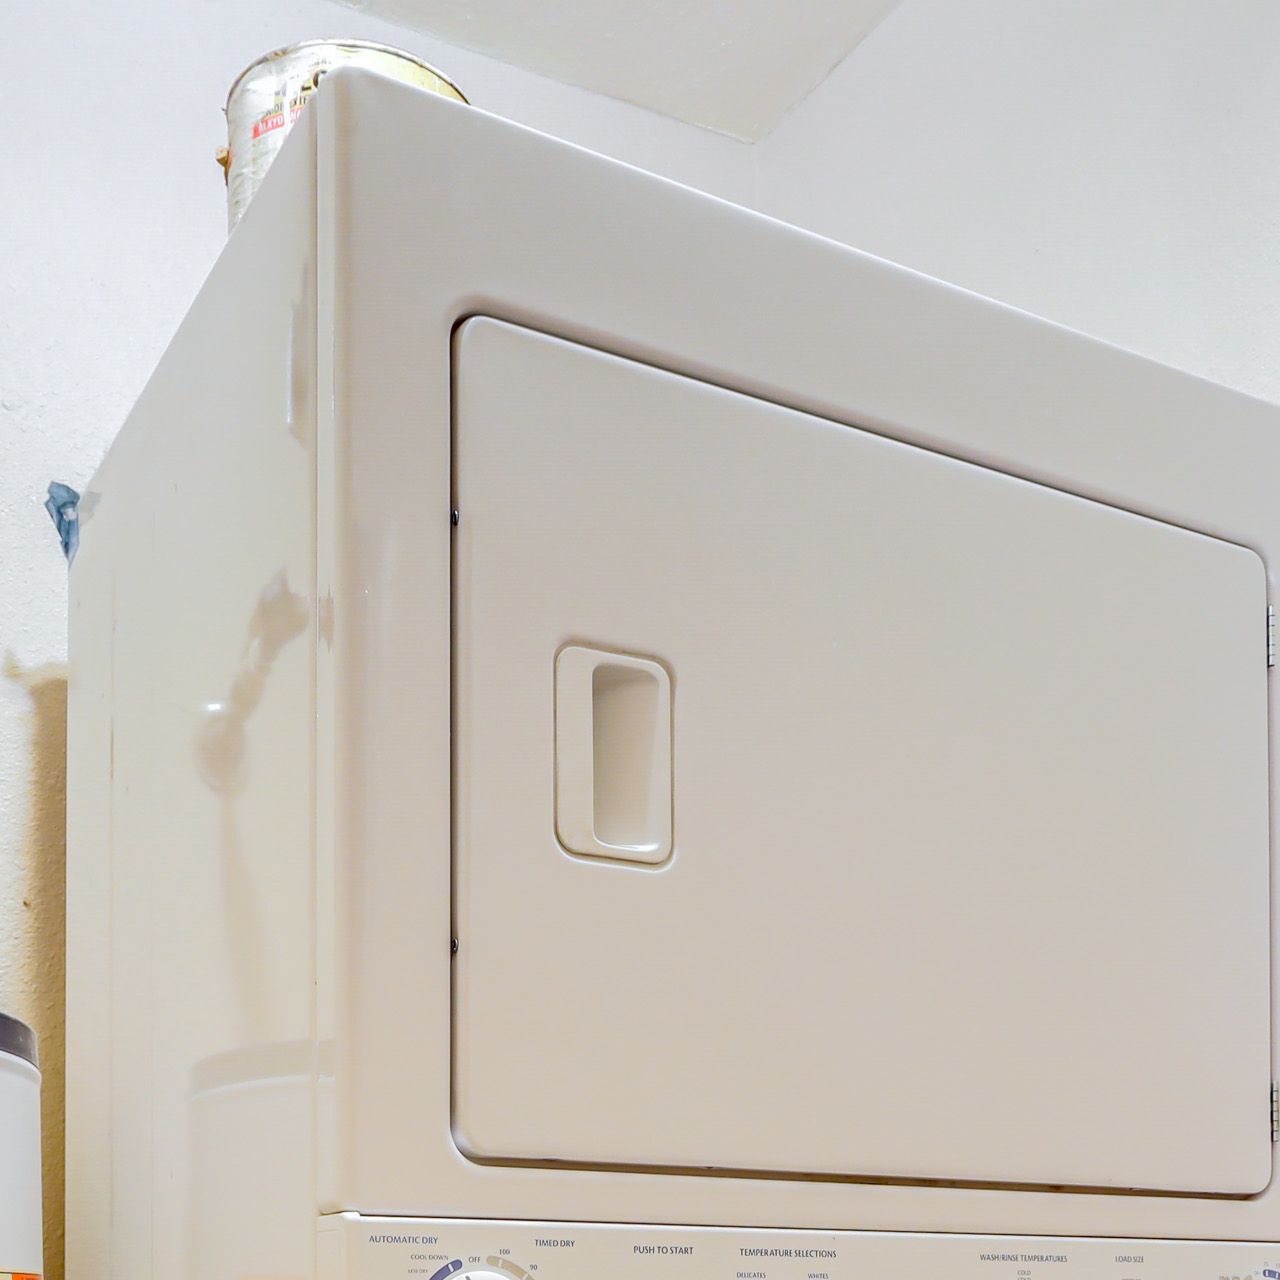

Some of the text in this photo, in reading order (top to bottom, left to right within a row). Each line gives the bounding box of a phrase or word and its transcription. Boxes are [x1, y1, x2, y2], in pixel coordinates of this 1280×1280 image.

[369, 1235, 438, 1245] AUTOMATIC DRY
[535, 1239, 575, 1247] TIMED DRY
[633, 1245, 694, 1255] PUSH TO START
[739, 1248, 836, 1258] TEMPERATURE SELECTIONS
[980, 1253, 1067, 1263] WASH/RINSE TEMPERATURES
[1115, 1255, 1144, 1263] LOAD SIZE
